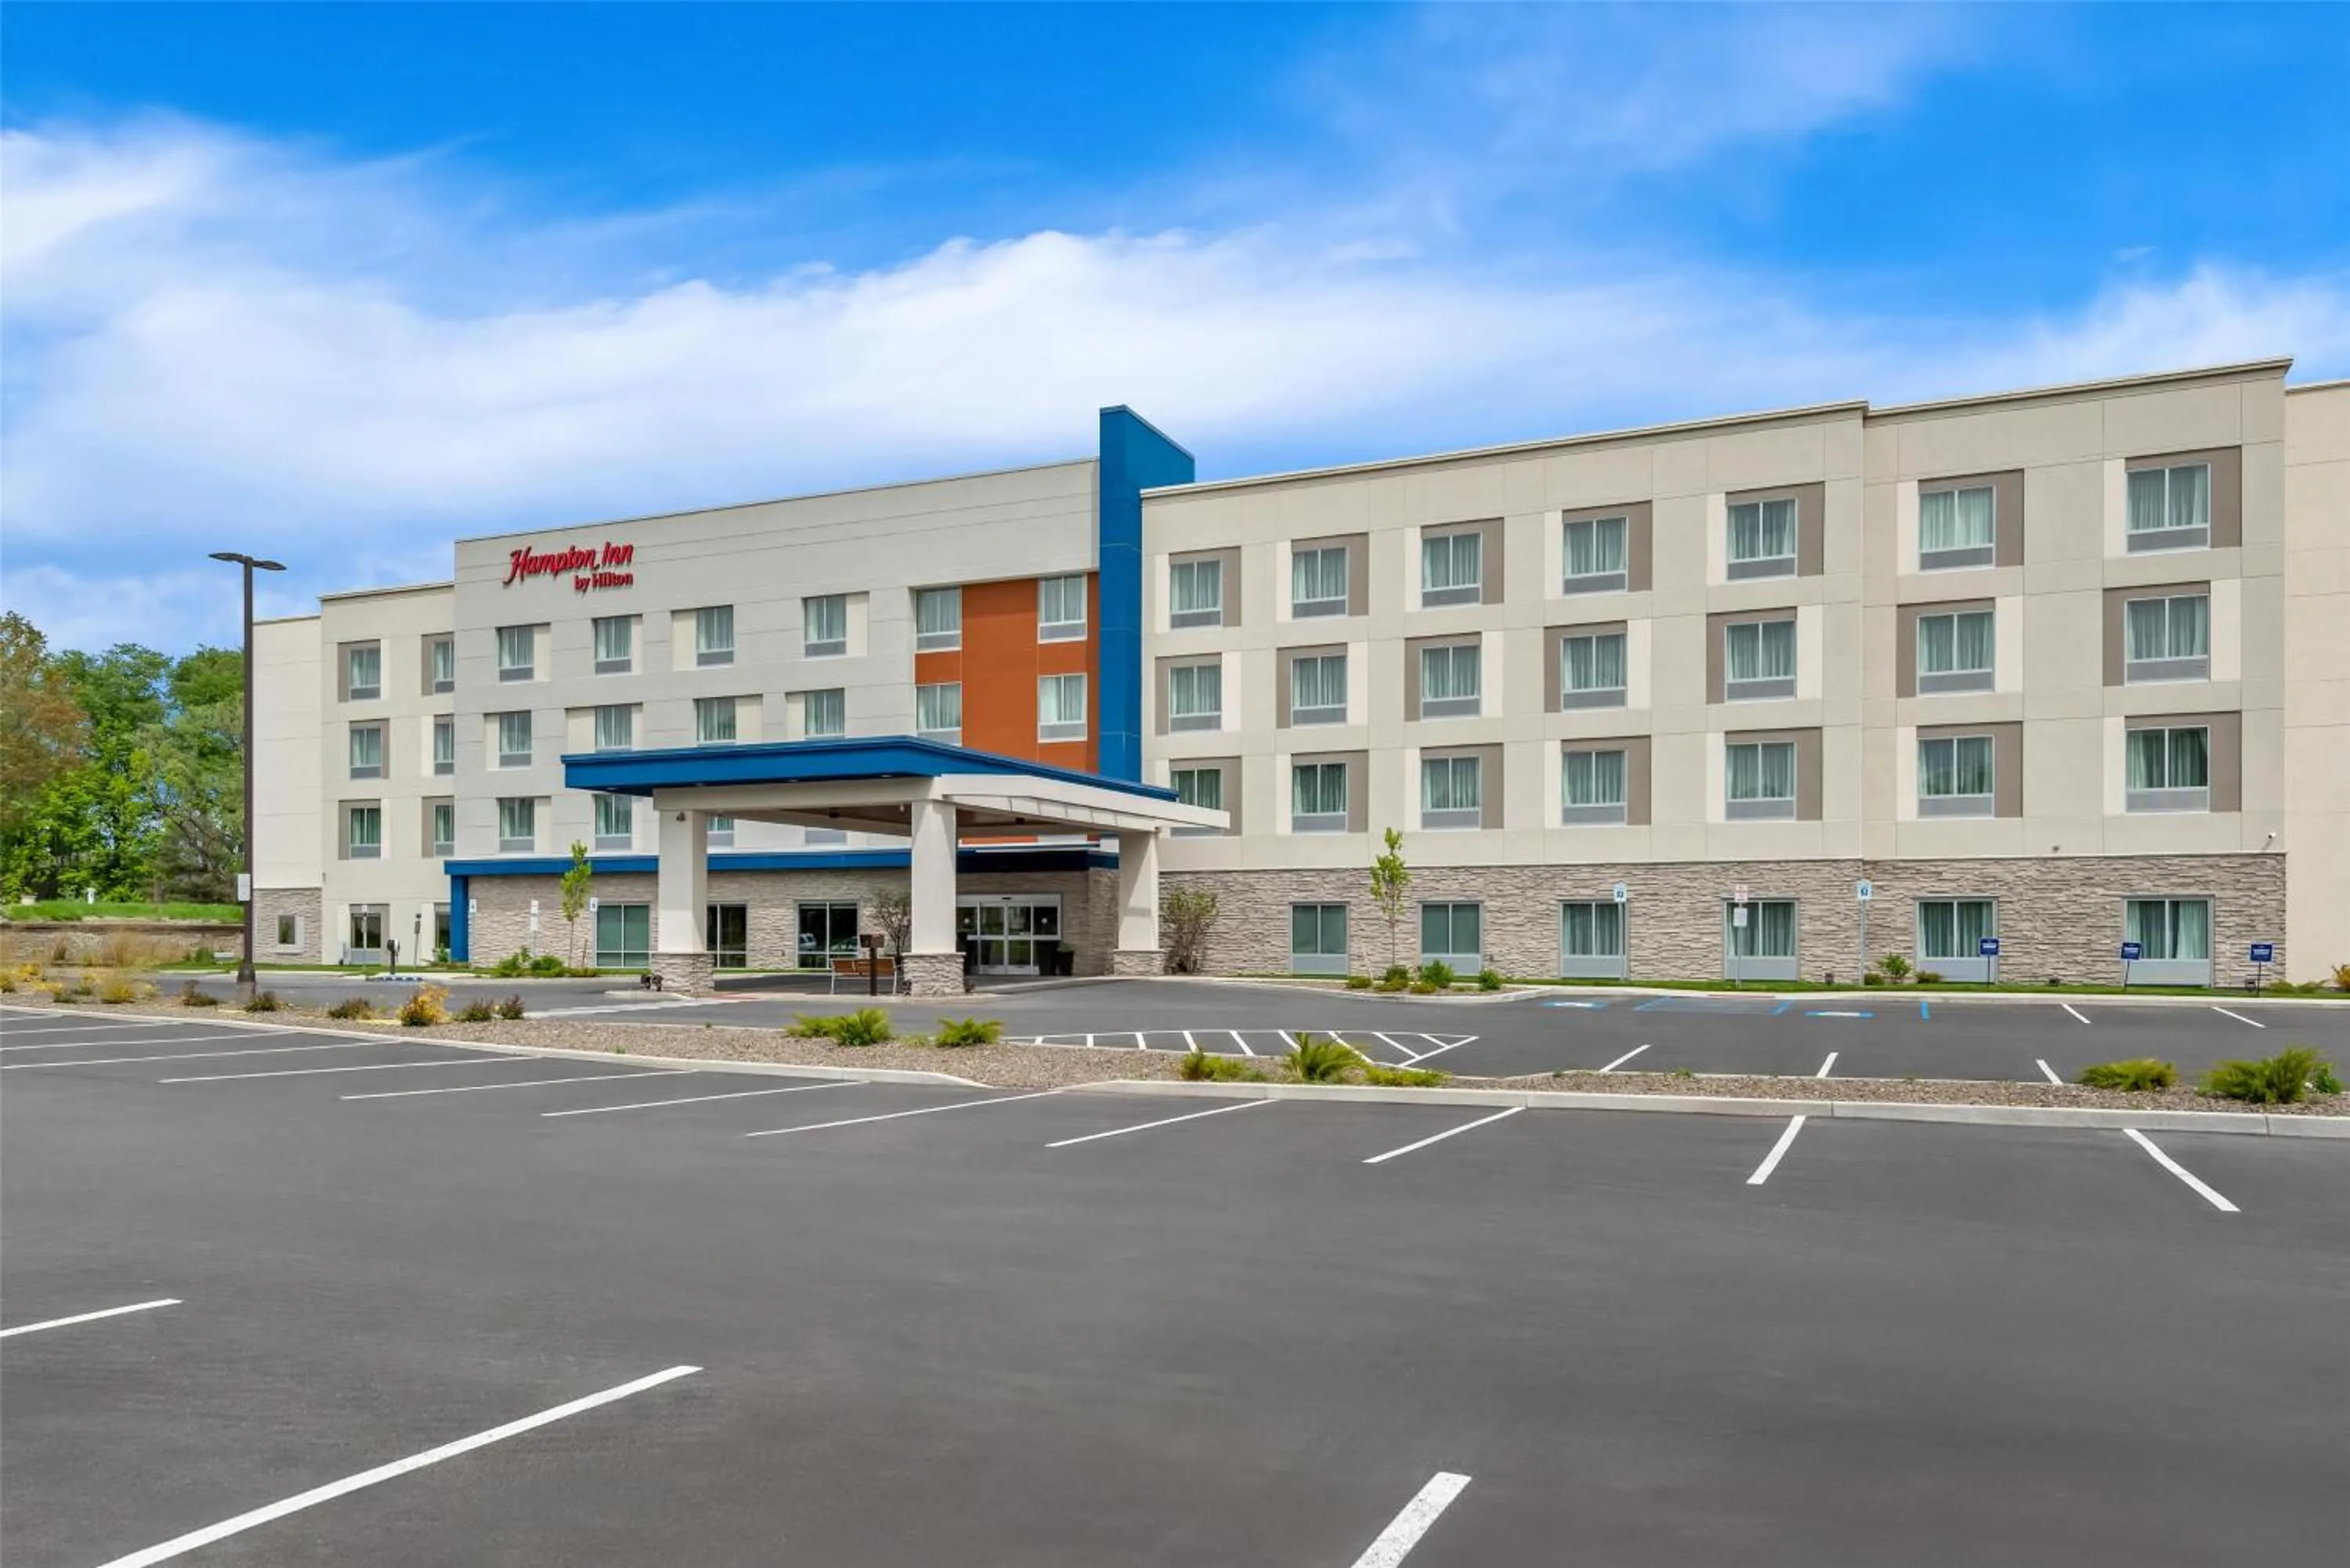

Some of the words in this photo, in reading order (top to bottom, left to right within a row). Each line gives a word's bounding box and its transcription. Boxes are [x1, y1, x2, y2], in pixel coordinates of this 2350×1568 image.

[502, 545, 600, 585] Hampton
[601, 541, 634, 565] Inn
[575, 574, 591, 594] by
[591, 572, 634, 588] Hilton
